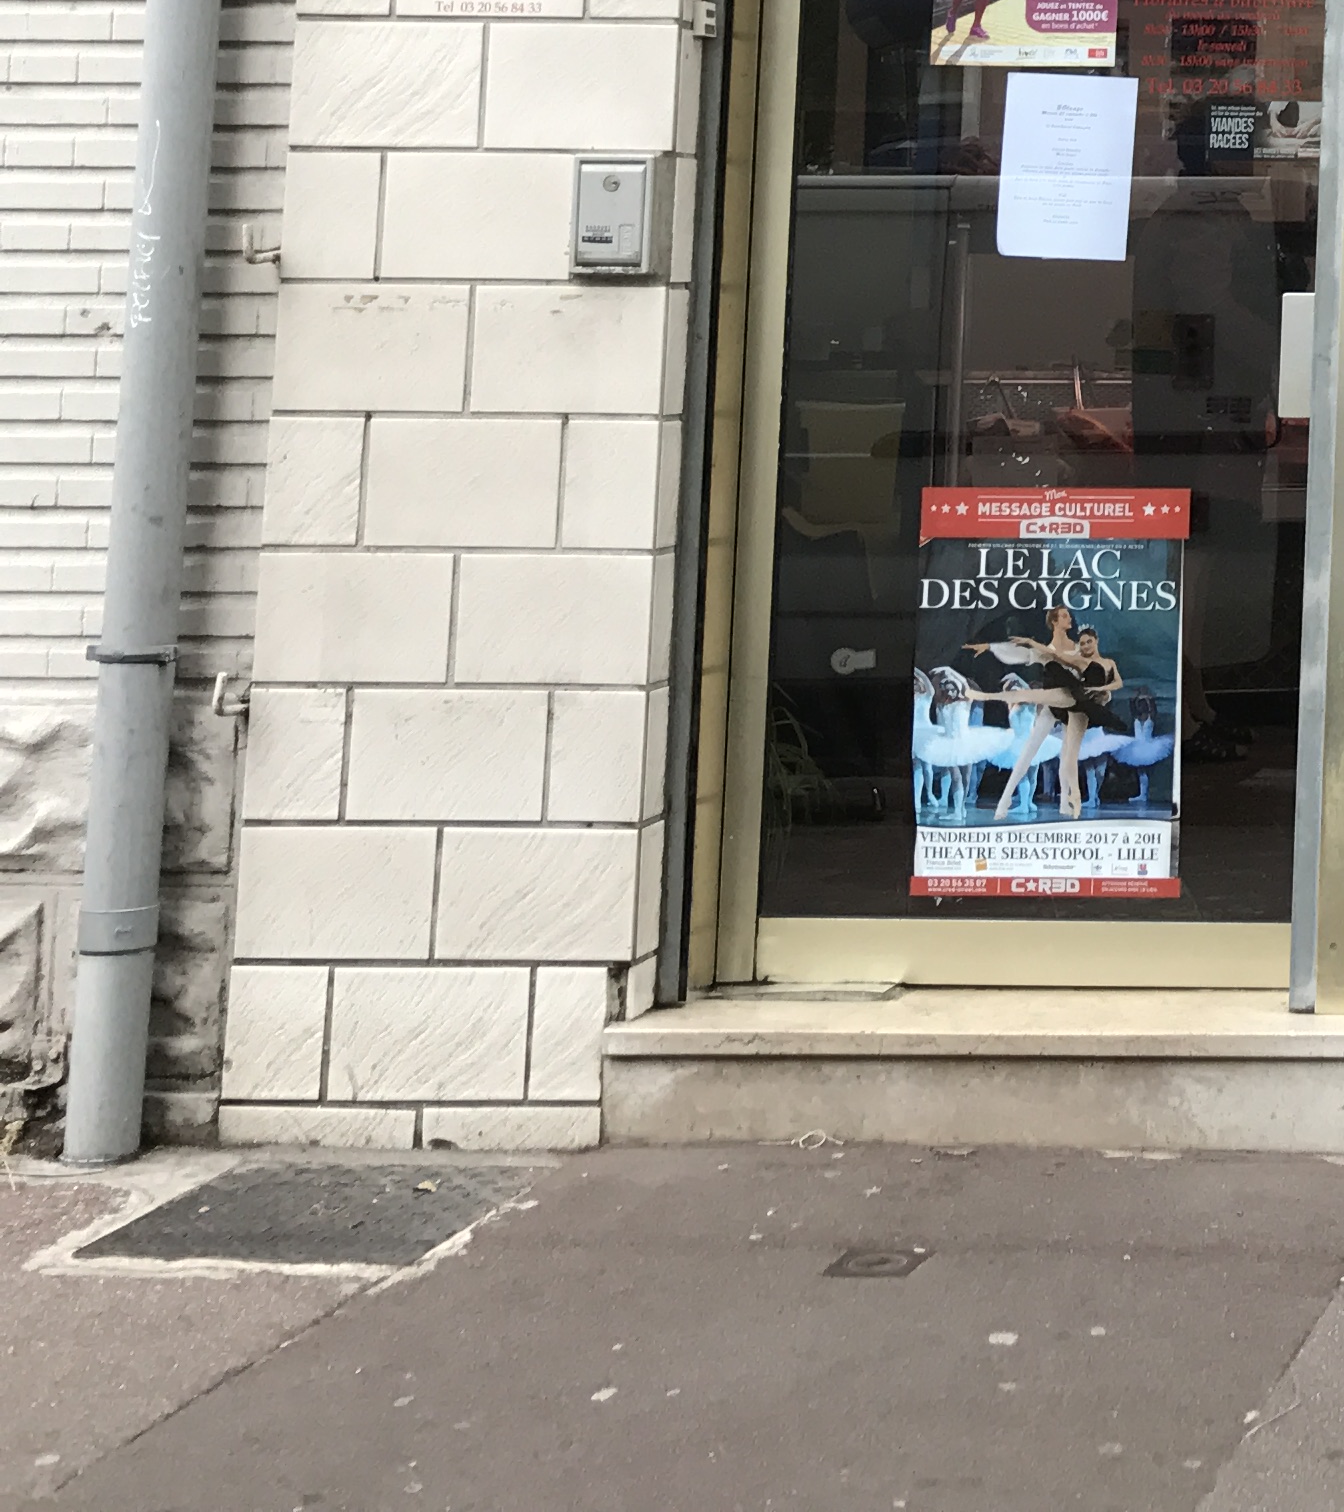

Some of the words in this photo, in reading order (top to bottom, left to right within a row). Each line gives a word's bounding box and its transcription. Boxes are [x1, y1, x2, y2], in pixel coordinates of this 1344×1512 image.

[434, 0, 454, 13] Tel
[460, 1, 475, 13] 03
[477, 1, 492, 13] 20
[528, 2, 542, 14] 33
[1032, 13, 1069, 21] GAGNER
[1072, 10, 1109, 22] 1000€
[1210, 117, 1255, 133] VIANDES
[1209, 131, 1249, 149] RACÉES
[977, 502, 1051, 516] MESSAGE
[1054, 502, 1134, 517] CULTUREL
[976, 548, 1030, 579] LE
[1042, 549, 1122, 580] LAC
[919, 578, 999, 610] DES
[1008, 580, 1177, 612] CYGNES
[920, 831, 991, 844] VENDREDI
[995, 832, 1003, 844] 8
[1007, 832, 1081, 844] DECEMBRE
[1085, 833, 1118, 845] 2017
[1122, 833, 1130, 844] à
[1134, 833, 1162, 845] 20H
[921, 846, 997, 859] THEATRE
[1001, 846, 1103, 861] SEBASTOPOL
[1117, 847, 1159, 861] LILLE
[927, 879, 938, 887] 03
[940, 879, 950, 887] 20
[952, 879, 962, 887] 56
